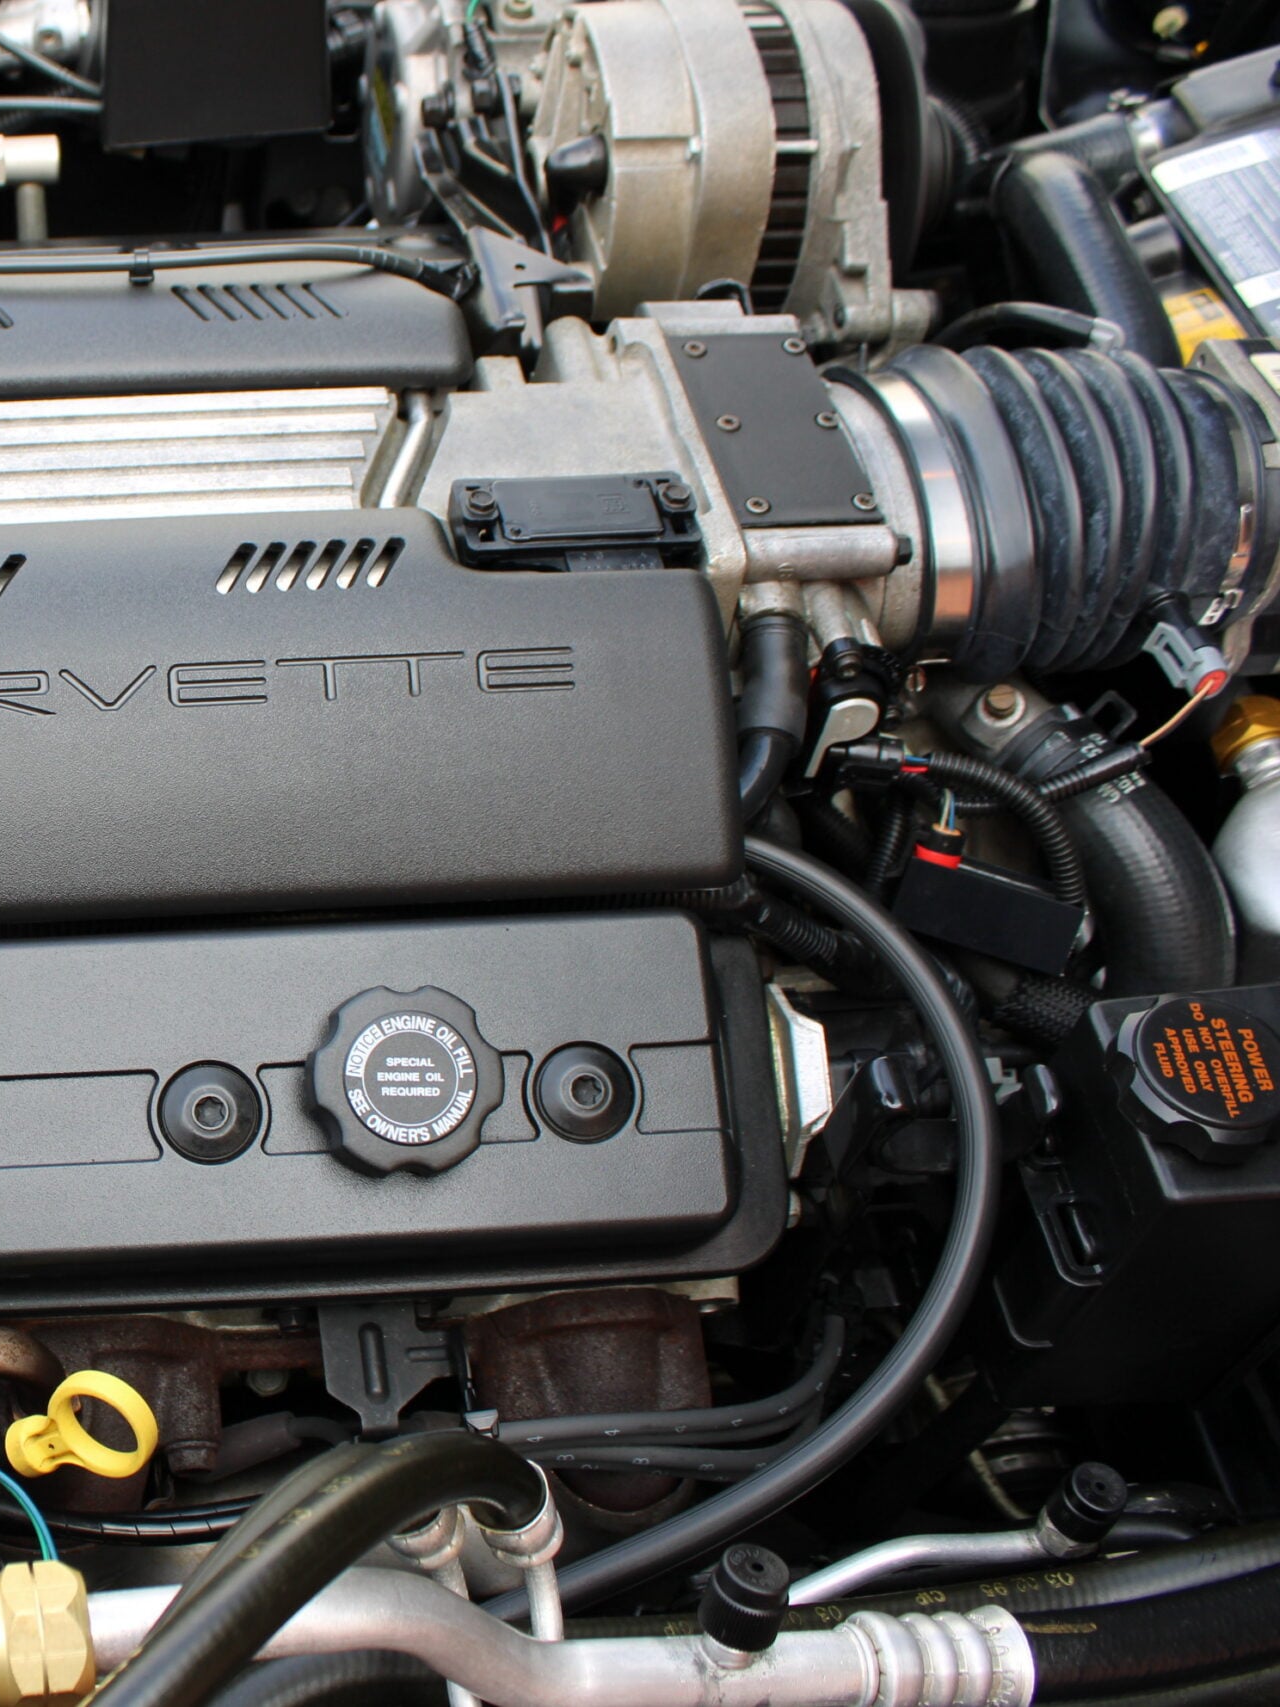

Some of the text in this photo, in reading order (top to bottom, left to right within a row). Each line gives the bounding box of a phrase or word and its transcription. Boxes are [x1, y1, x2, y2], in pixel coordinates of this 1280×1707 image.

[347, 1015, 473, 1078] NOTICE ENGINE OIL FILL
[377, 1072, 445, 1081] ENGINE OIL
[386, 1057, 435, 1067] SPECIAL
[1153, 1042, 1175, 1078] FLUID
[1164, 1028, 1198, 1094] APPROVED
[1182, 1028, 1214, 1091] USE ONLY
[1189, 1002, 1241, 1118] DO NOT OVERFILL
[1210, 1018, 1254, 1103] STEERING
[1238, 1028, 1274, 1091] POWER
[348, 1089, 473, 1143] SEE OWNER'S MANUAL
[381, 1087, 440, 1096] REQUIRED
